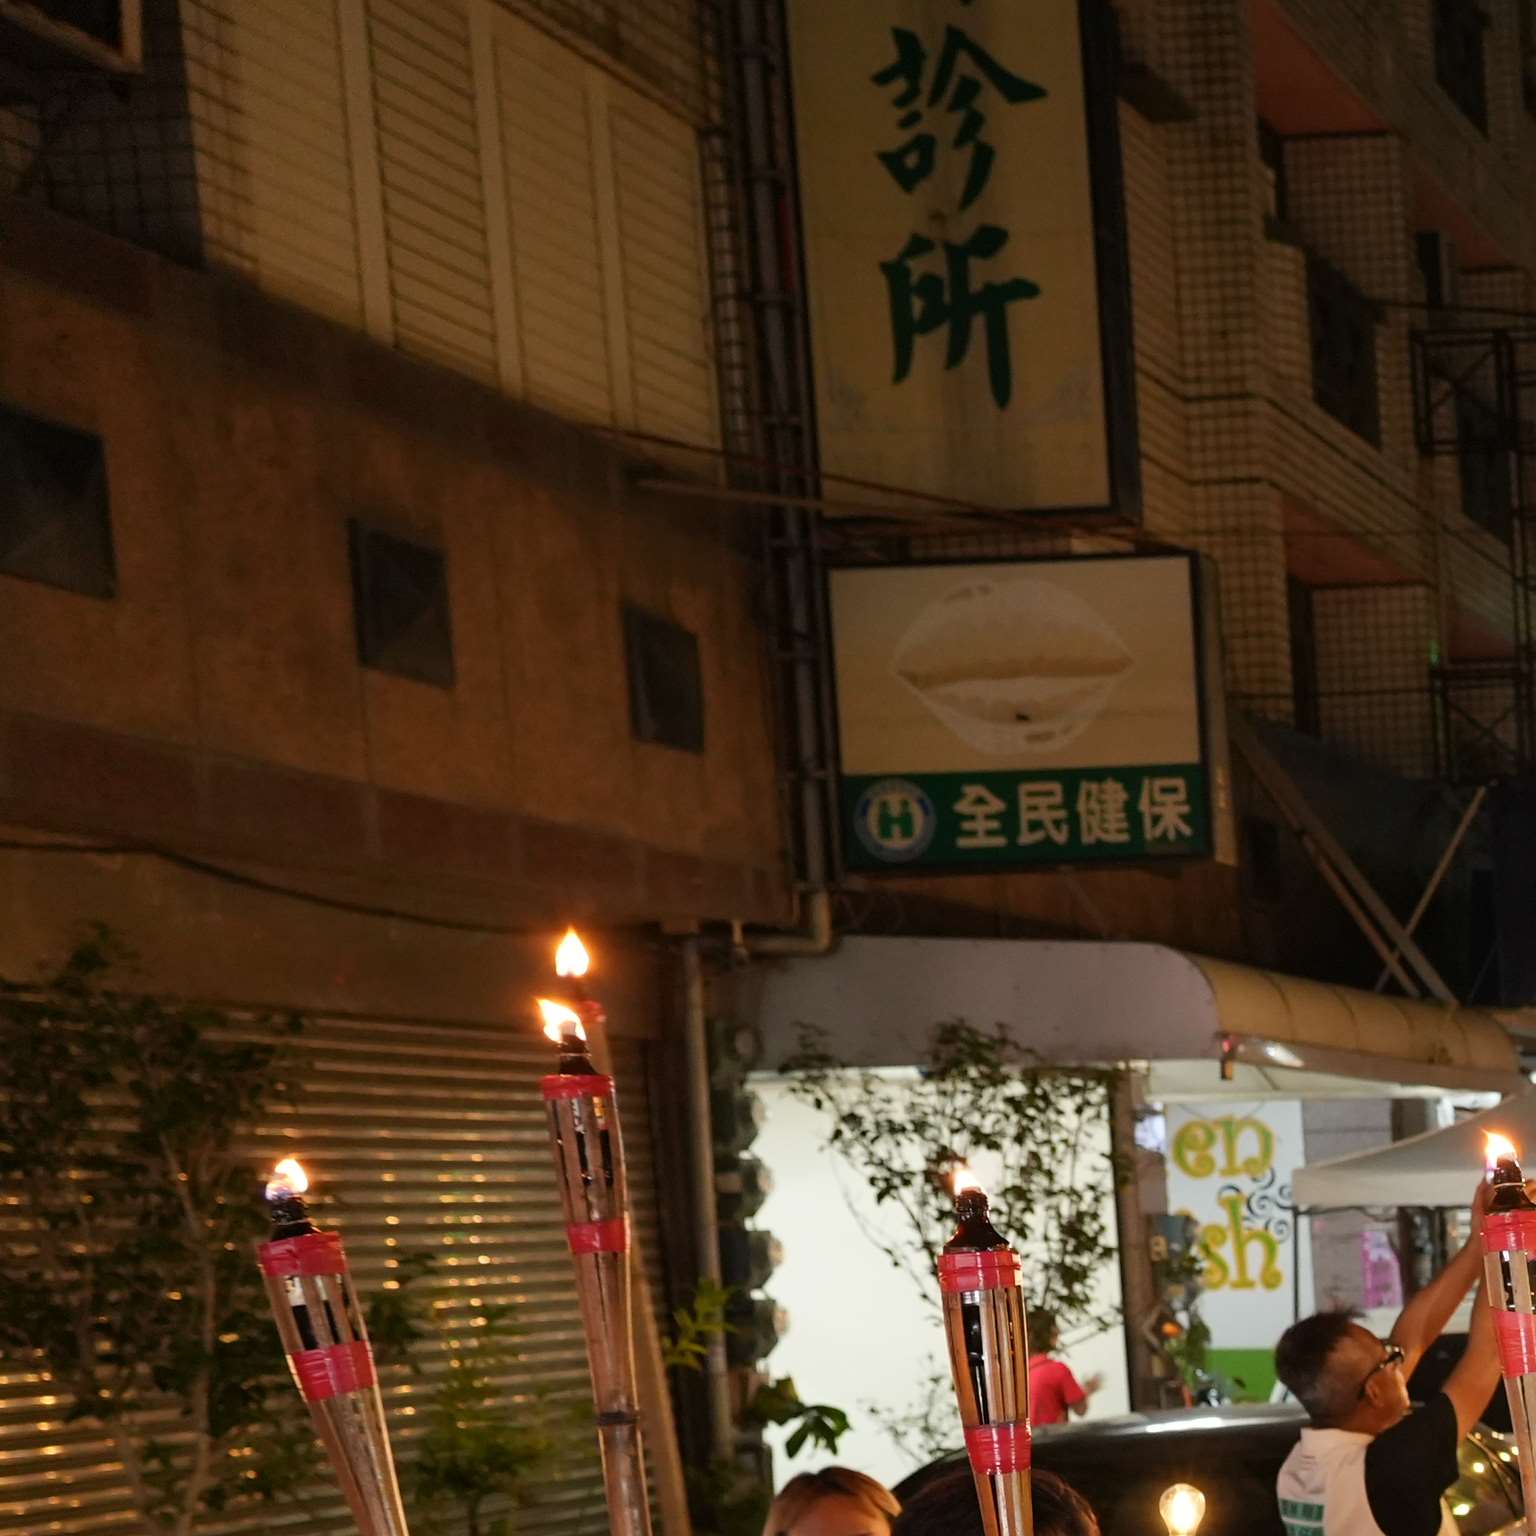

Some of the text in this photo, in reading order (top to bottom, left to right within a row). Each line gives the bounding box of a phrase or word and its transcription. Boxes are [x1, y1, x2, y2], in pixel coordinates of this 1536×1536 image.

[870, 24, 1048, 411] 診所
[952, 776, 1193, 848] 全民健保
[1171, 1115, 1276, 1178] en
[1184, 1191, 1284, 1291] sh
